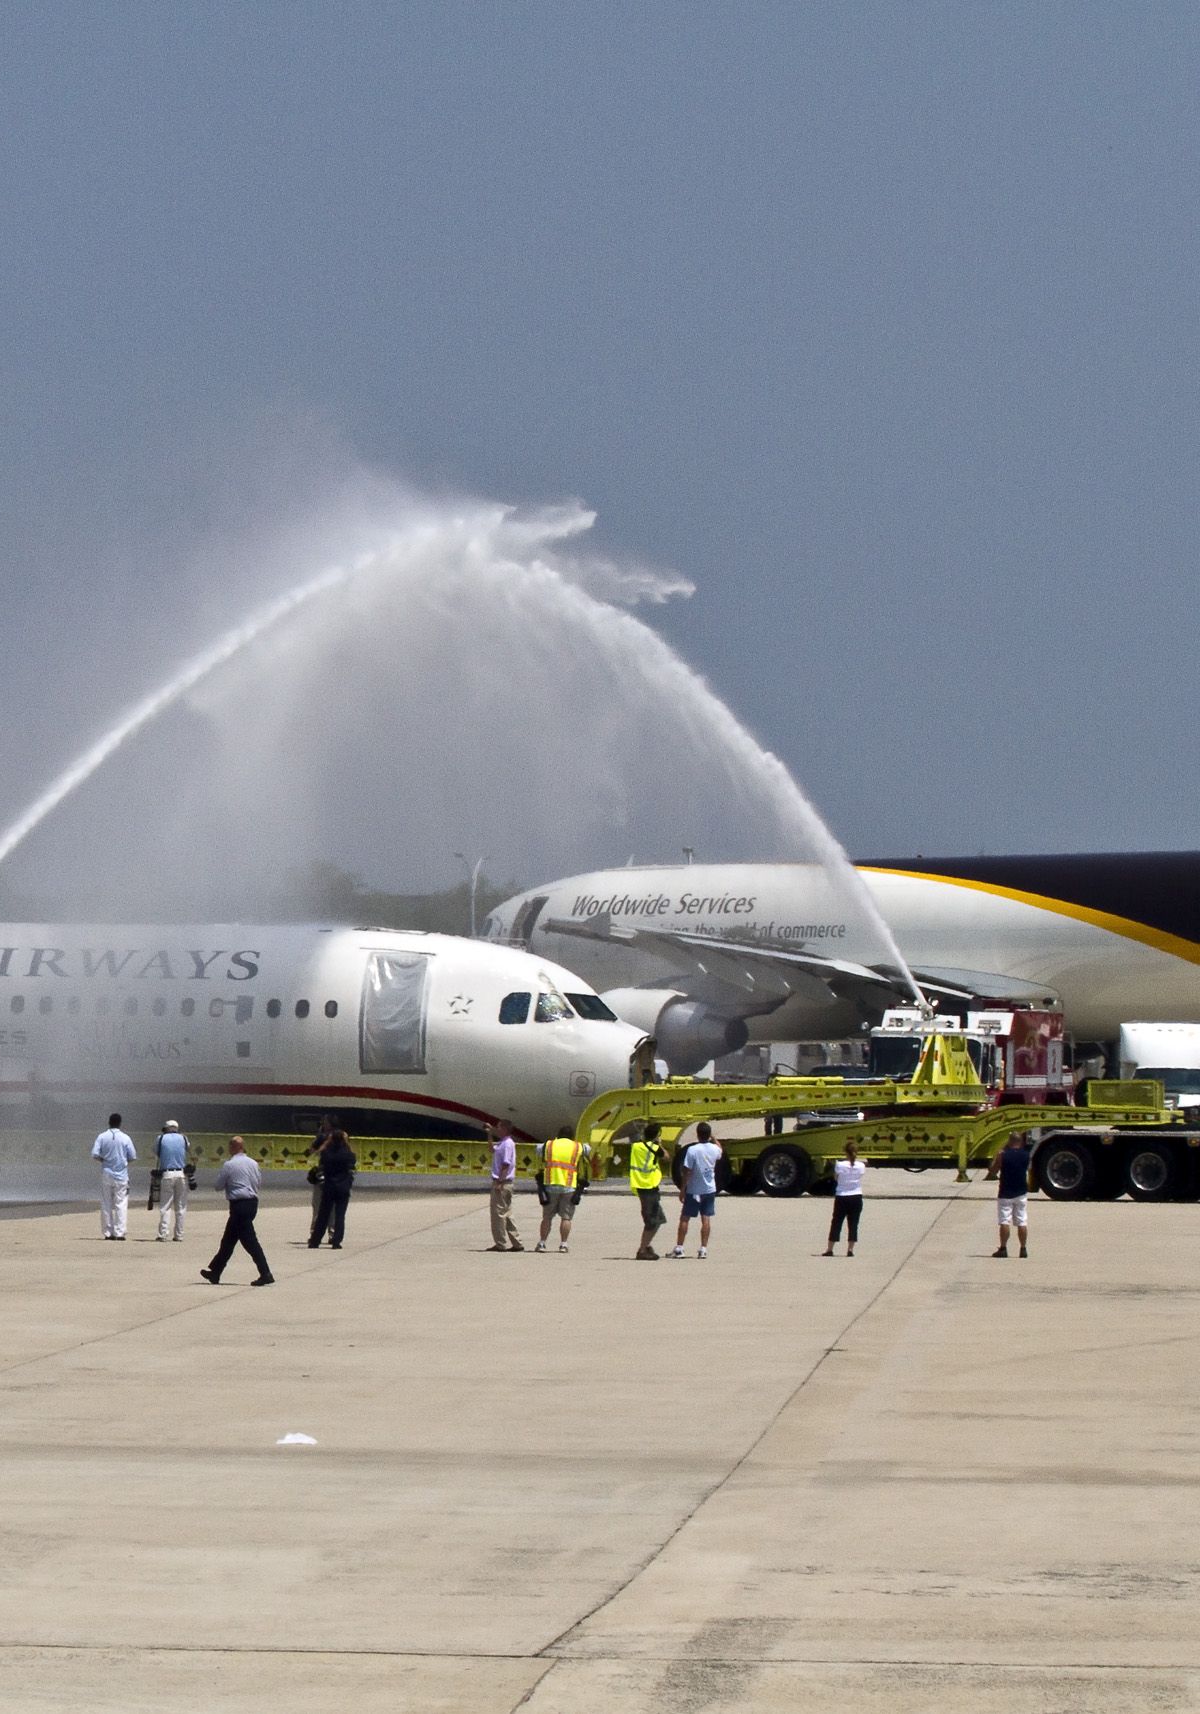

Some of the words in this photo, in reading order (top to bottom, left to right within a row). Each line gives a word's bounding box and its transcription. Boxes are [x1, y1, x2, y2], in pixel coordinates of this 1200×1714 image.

[571, 893, 670, 917] Worldwide
[674, 893, 758, 915] Services
[777, 923, 846, 939] commerce
